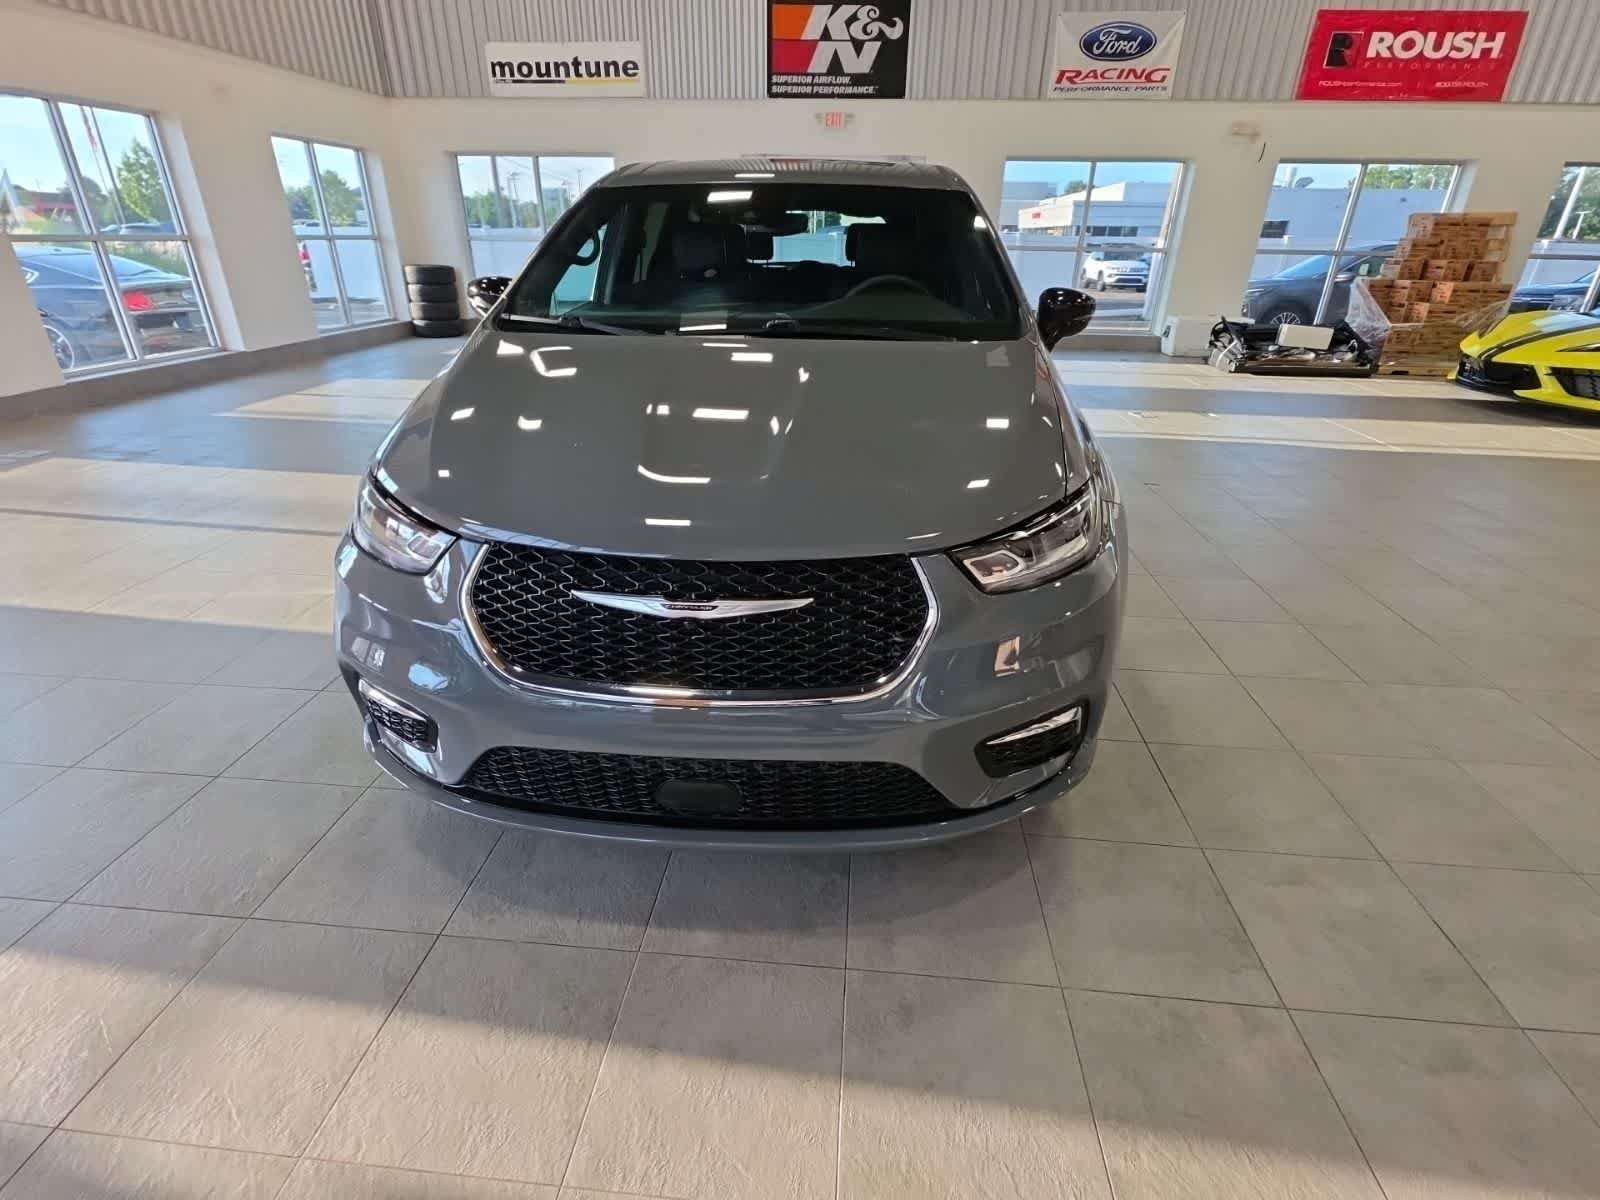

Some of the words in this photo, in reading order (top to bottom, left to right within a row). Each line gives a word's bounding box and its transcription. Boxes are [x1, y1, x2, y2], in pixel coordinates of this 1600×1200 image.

[1093, 28, 1142, 54] Ford
[1366, 30, 1506, 59] ROUSH
[490, 56, 640, 78] mountune
[771, 75, 812, 84] SUPERIOR
[813, 75, 852, 84] AIRFLOW.
[1055, 68, 1171, 85] RACING
[771, 85, 812, 94] SUPERIOR
[1053, 85, 1130, 93] PERFORMANCE
